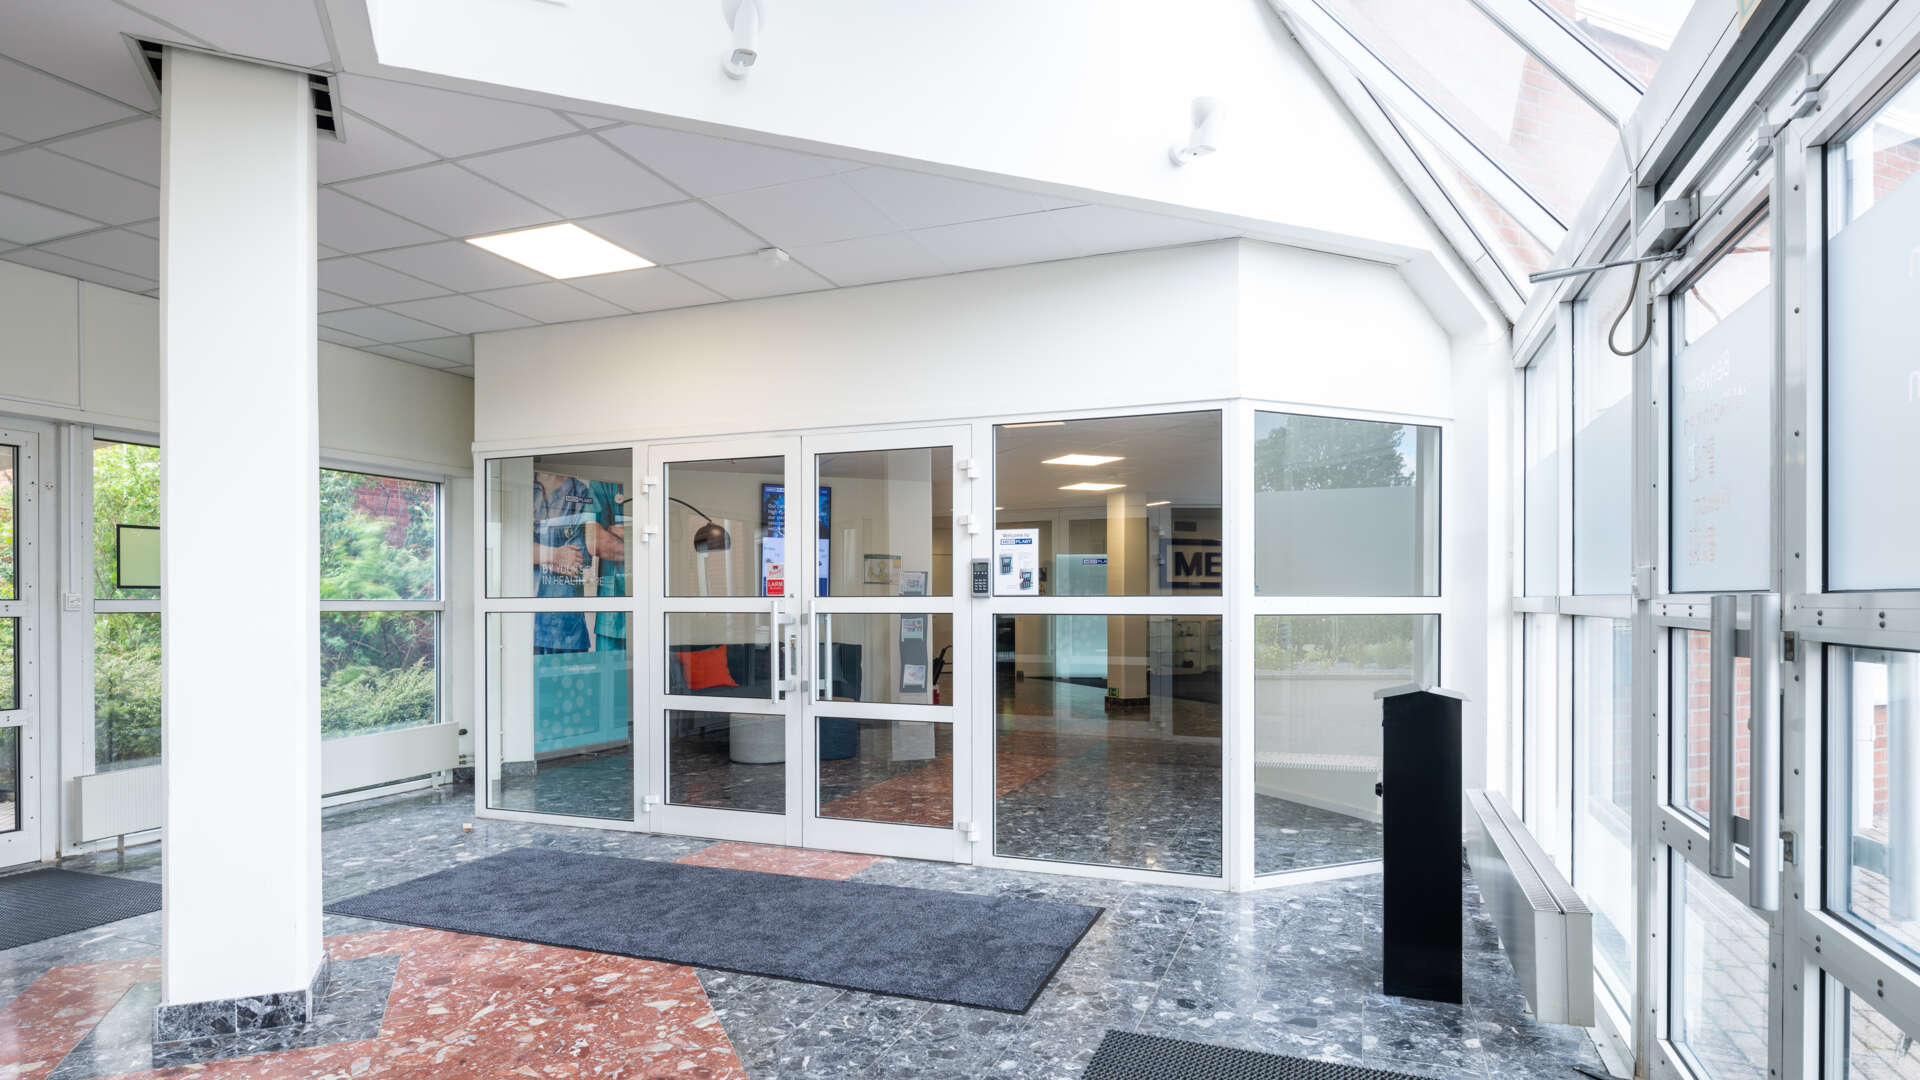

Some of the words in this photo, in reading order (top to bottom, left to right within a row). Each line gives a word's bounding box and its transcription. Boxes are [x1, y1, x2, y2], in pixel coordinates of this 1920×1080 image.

[1175, 552, 1221, 576] ME
[542, 575, 552, 585] IN
[554, 575, 604, 587] HEALTHARE
